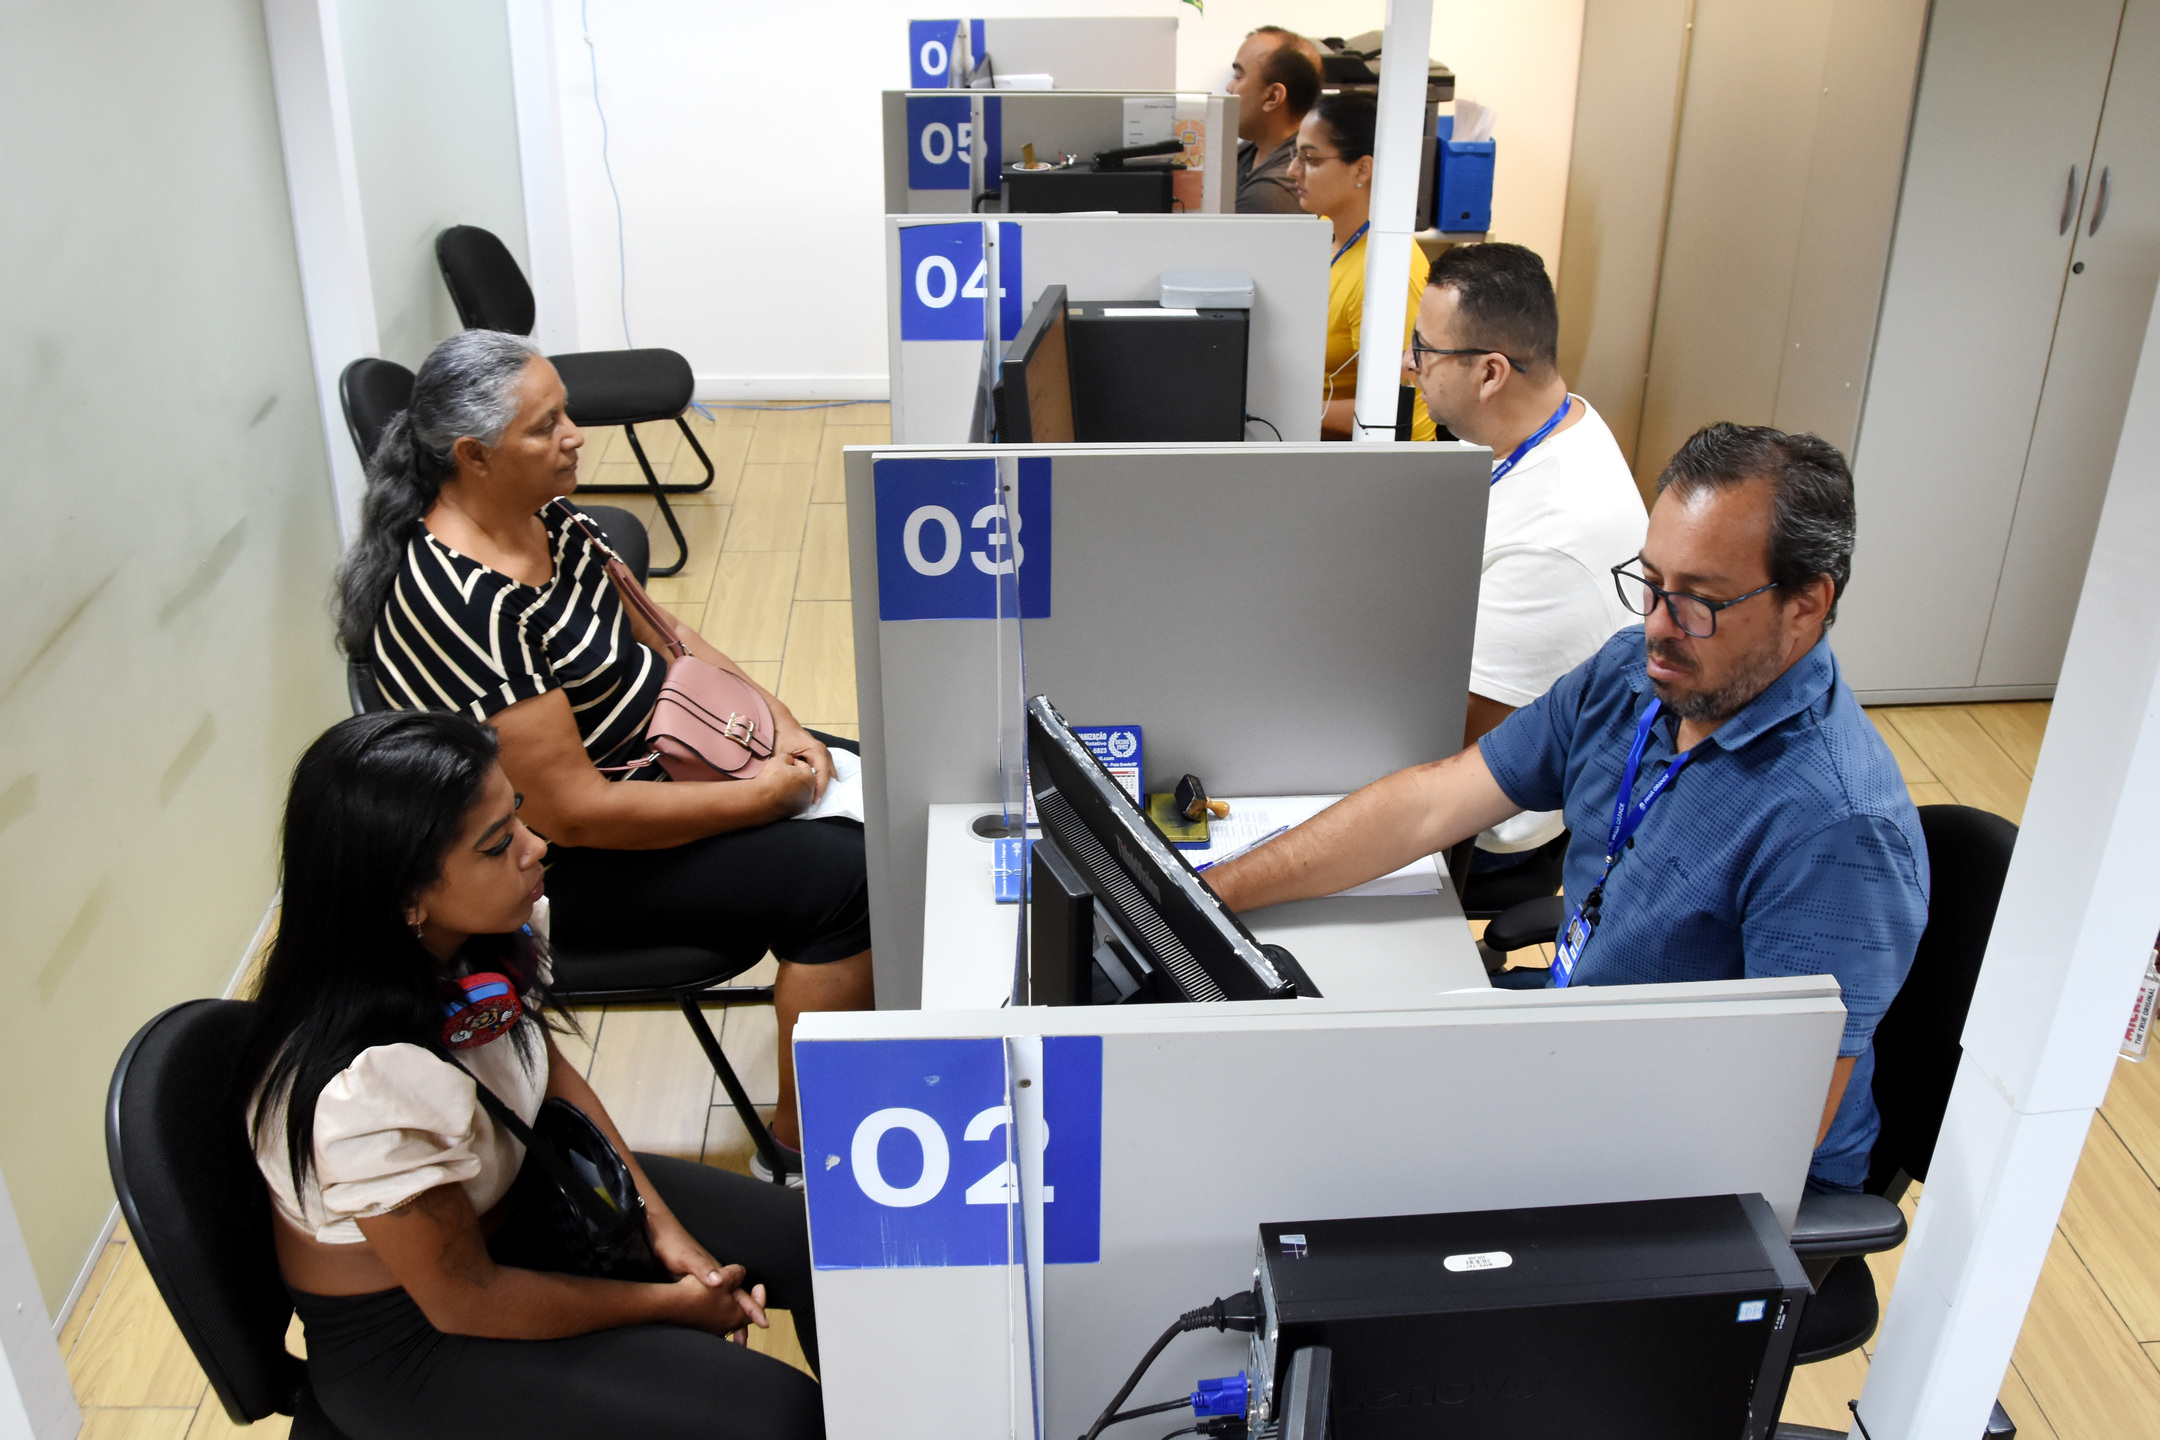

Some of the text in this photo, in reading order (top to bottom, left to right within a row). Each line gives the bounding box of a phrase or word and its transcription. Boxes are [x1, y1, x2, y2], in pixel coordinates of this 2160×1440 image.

[921, 122, 988, 165] 05
[915, 255, 1006, 309] 04
[903, 504, 1025, 577] 03
[1077, 731, 1107, 741] ANIZAÇÃO
[2135, 987, 2155, 1046] THE TRUE ORIGINAL
[851, 1105, 1054, 1208] 02
